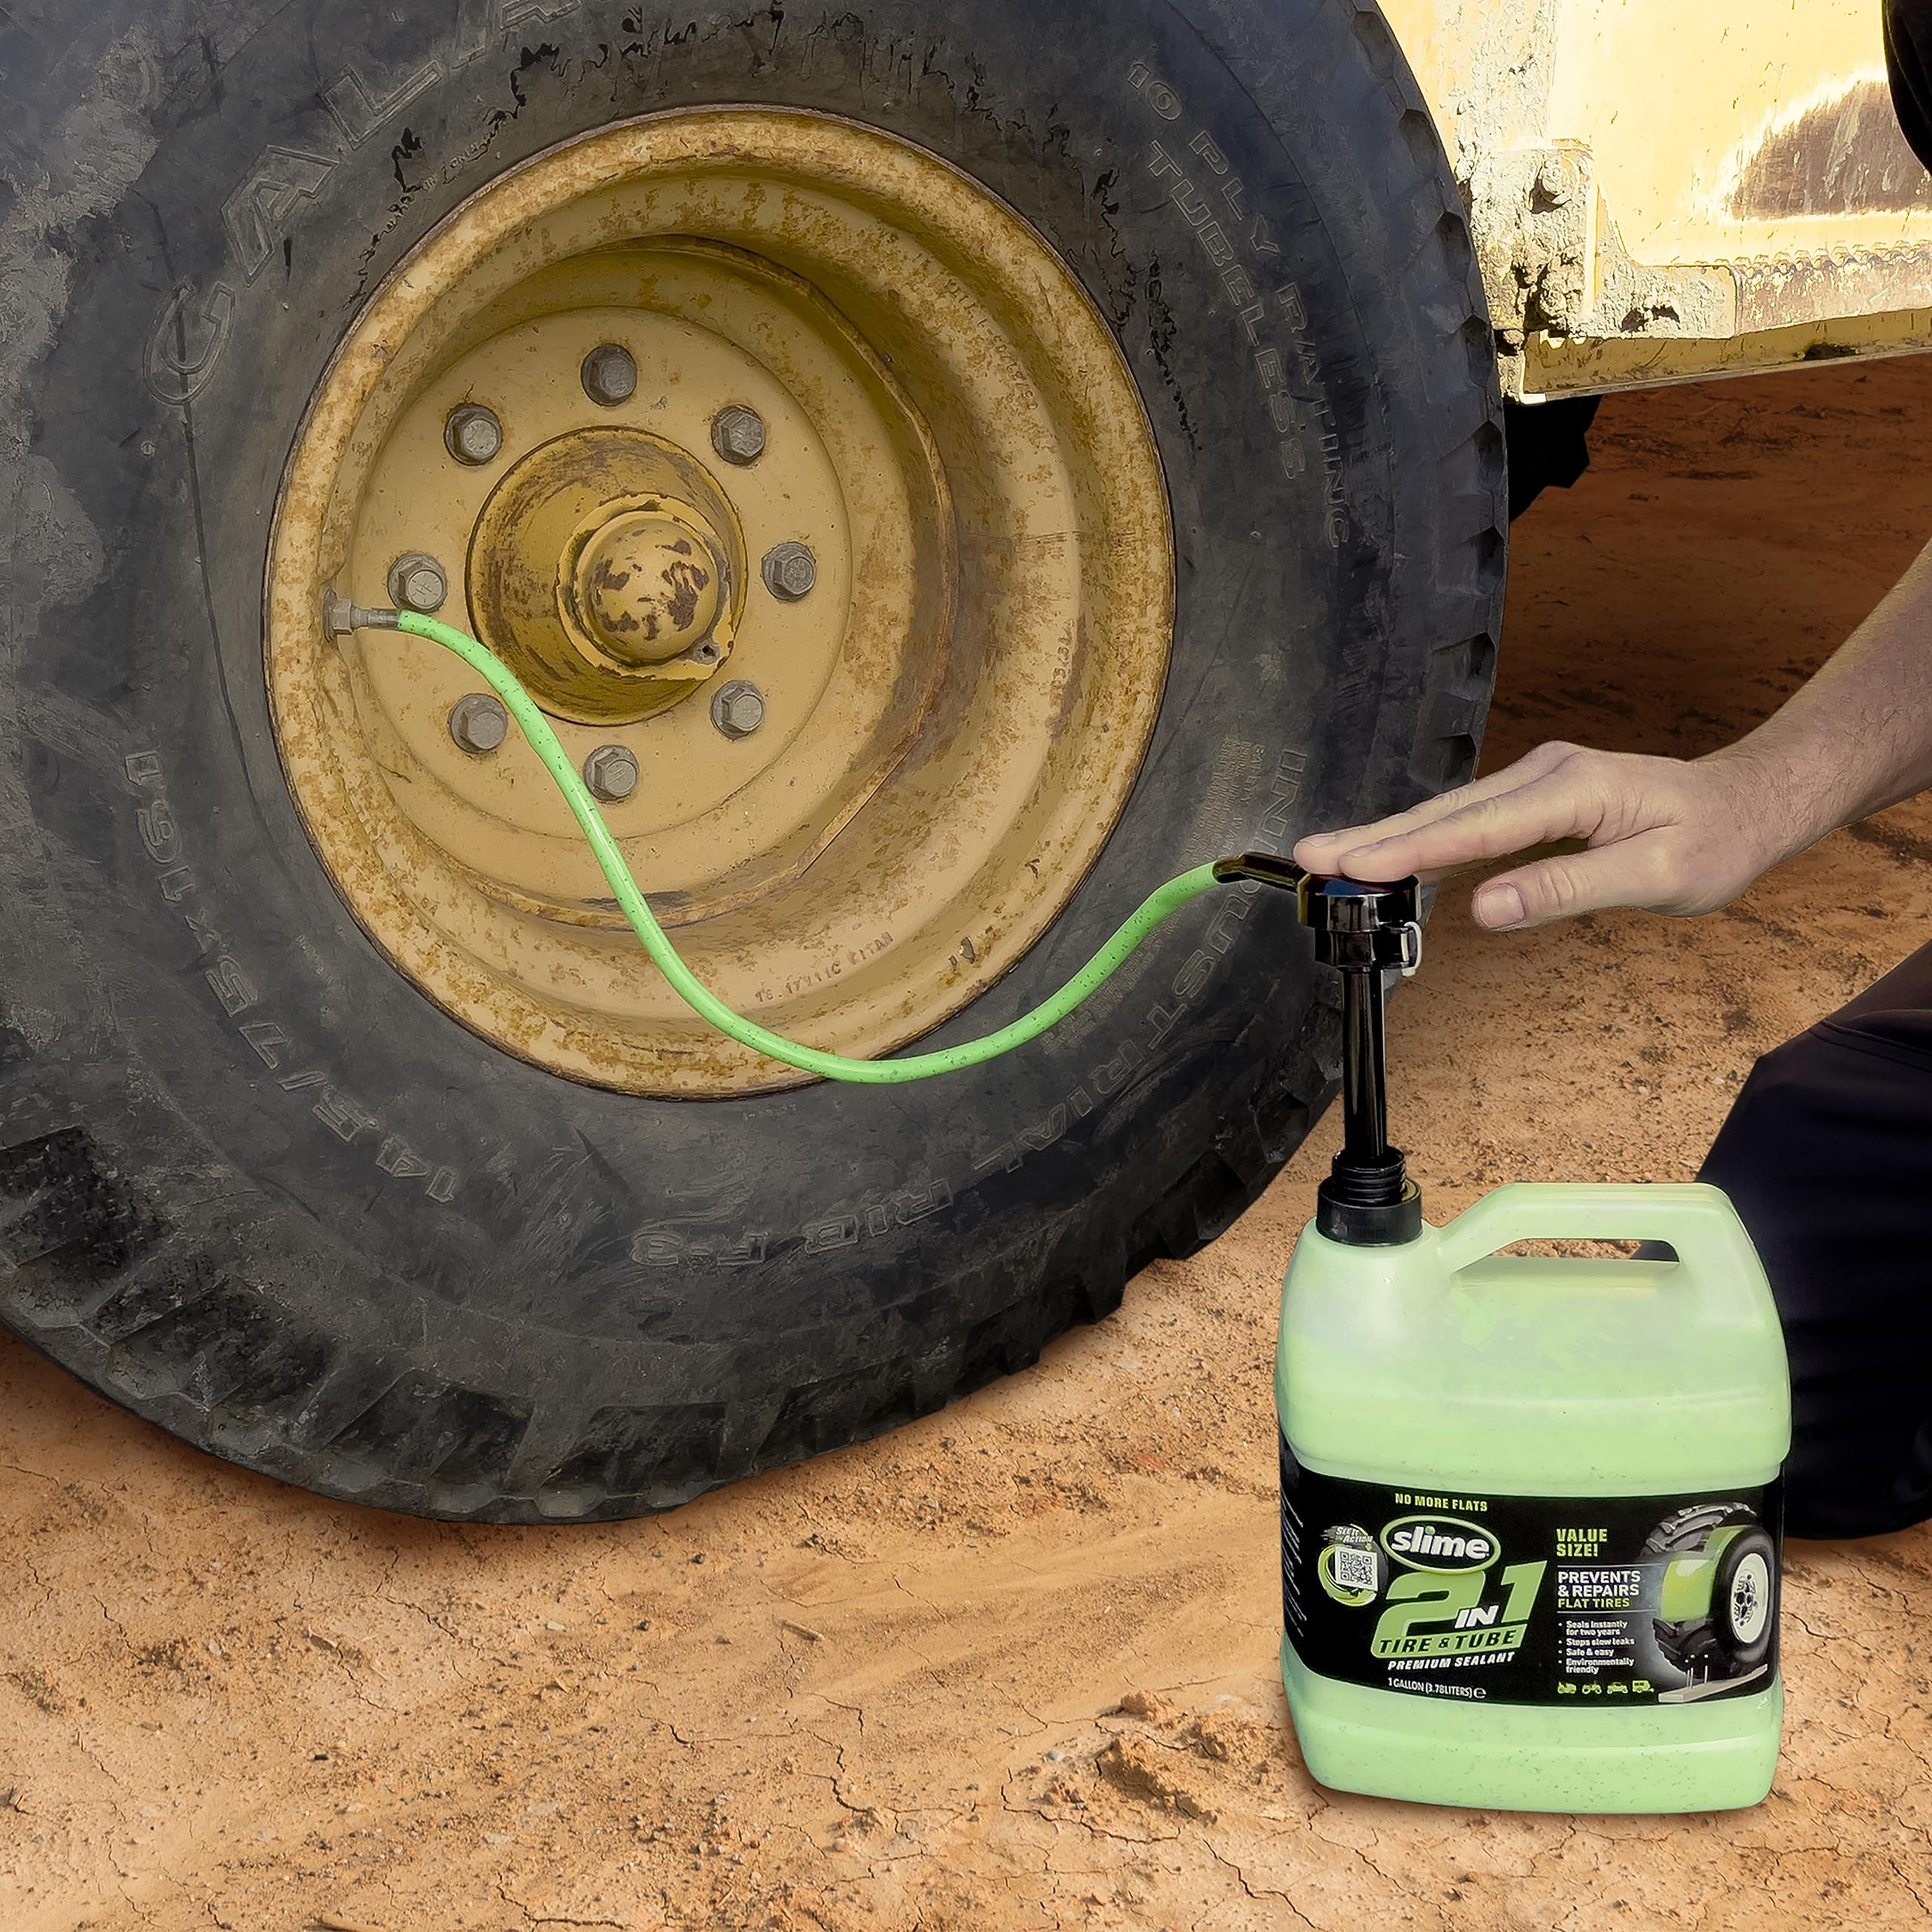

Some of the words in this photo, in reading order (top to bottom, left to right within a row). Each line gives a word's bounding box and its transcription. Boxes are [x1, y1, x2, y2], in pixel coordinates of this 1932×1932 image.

[1128, 62, 1183, 120] 10
[1189, 131, 1280, 255] PLY
[1275, 281, 1349, 549] RATING
[1148, 140, 1305, 479] TUBELESS
[1395, 1493, 1411, 1505] NO
[1414, 1496, 1449, 1509] MORE
[1452, 1500, 1487, 1512] FLATS
[1391, 1525, 1490, 1559] slime
[1556, 1528, 1607, 1542] VALUE
[1556, 1543, 1598, 1557] SIZE!
[1558, 1571, 1641, 1583] PREVENTS
[1558, 1585, 1569, 1597] &
[1572, 1584, 1639, 1597] REPAIRS
[1371, 1570, 1486, 1658] 2
[1454, 1604, 1499, 1629] IN
[1500, 1560, 1547, 1623] 1
[1558, 1598, 1589, 1608] FLAT
[1592, 1598, 1630, 1608] TIRES
[1598, 1629, 1620, 1637] years
[1379, 1637, 1432, 1654] TIRE
[1438, 1637, 1451, 1648] &
[1454, 1629, 1517, 1650] TUBE
[1566, 1638, 1590, 1647] Stops
[1388, 1657, 1451, 1670] PREMIUM
[1454, 1651, 1515, 1667] SEALANT
[1566, 1657, 1634, 1666] Environmentally
[1566, 1666, 1599, 1674] friendly
[1393, 1678, 1424, 1691] GALLON
